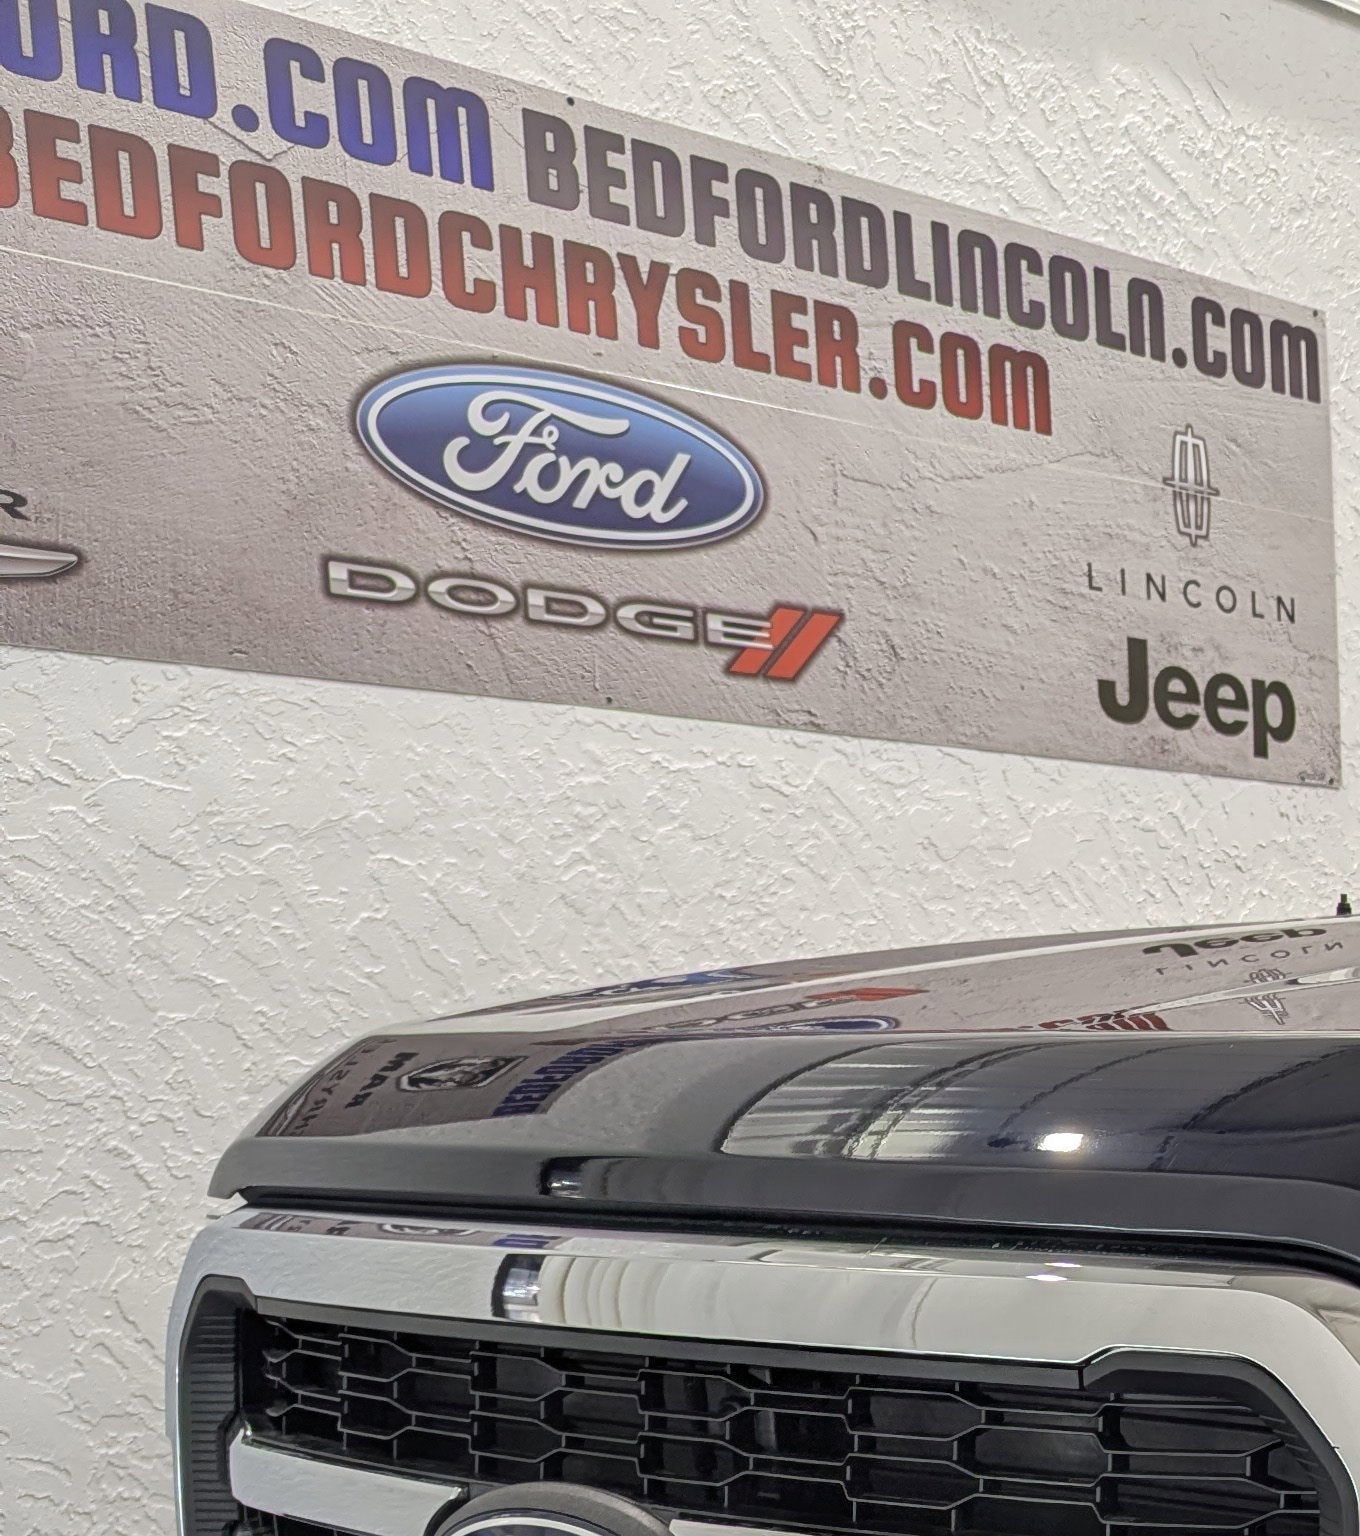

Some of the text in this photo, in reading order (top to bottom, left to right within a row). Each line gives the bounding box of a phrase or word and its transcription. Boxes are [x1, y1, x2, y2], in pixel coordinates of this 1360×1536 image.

[443, 390, 692, 523] Ford
[327, 560, 775, 651] DODGE
[1087, 562, 1295, 625] LINCOLN
[1097, 636, 1296, 760] Jeep
